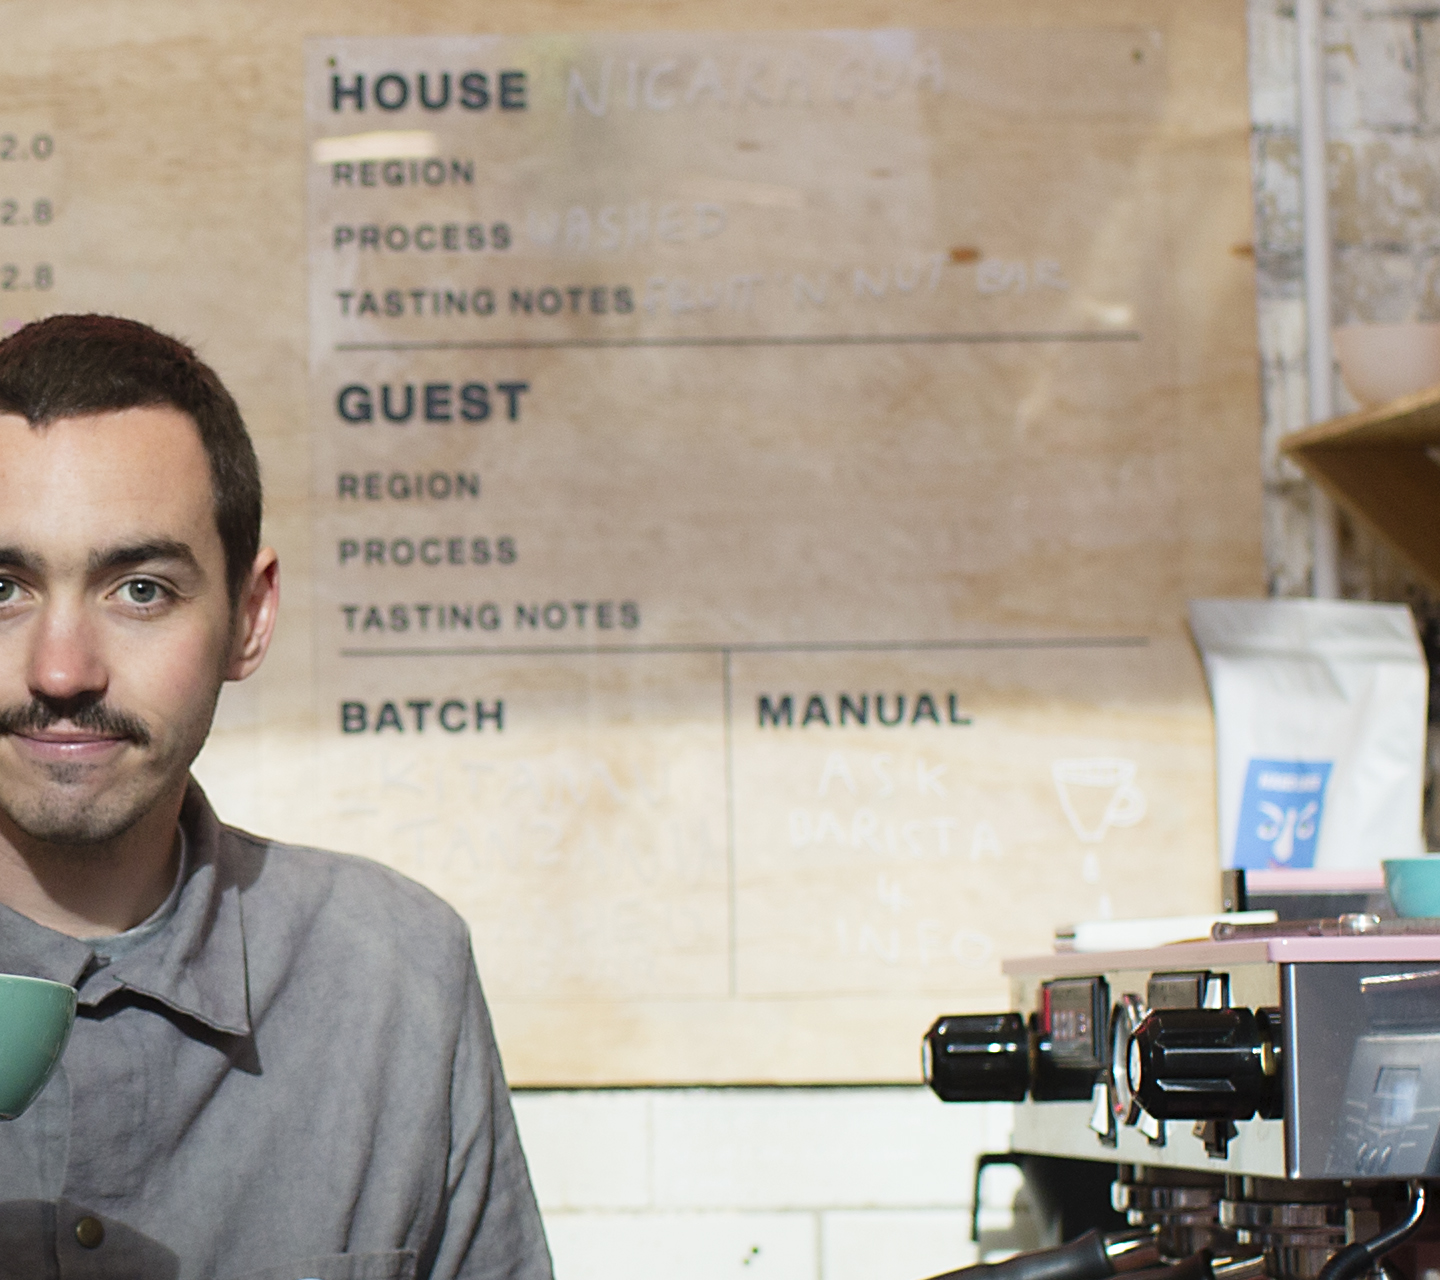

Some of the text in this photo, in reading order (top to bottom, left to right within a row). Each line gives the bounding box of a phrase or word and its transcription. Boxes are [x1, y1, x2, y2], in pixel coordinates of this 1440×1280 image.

[327, 67, 529, 114] HOUSE
[330, 160, 474, 188] REGION
[333, 222, 513, 252] PROCESS
[337, 286, 634, 317] TASTING NOTES
[337, 380, 530, 424] GUEST
[337, 472, 481, 502] REGION
[339, 538, 517, 567] PROCESS
[341, 600, 641, 634] TASTING NOTES
[341, 693, 973, 737] BATCH MANUAL
[818, 749, 949, 800] ASK
[787, 808, 1004, 864] BARISTA
[833, 914, 995, 970] INFO
